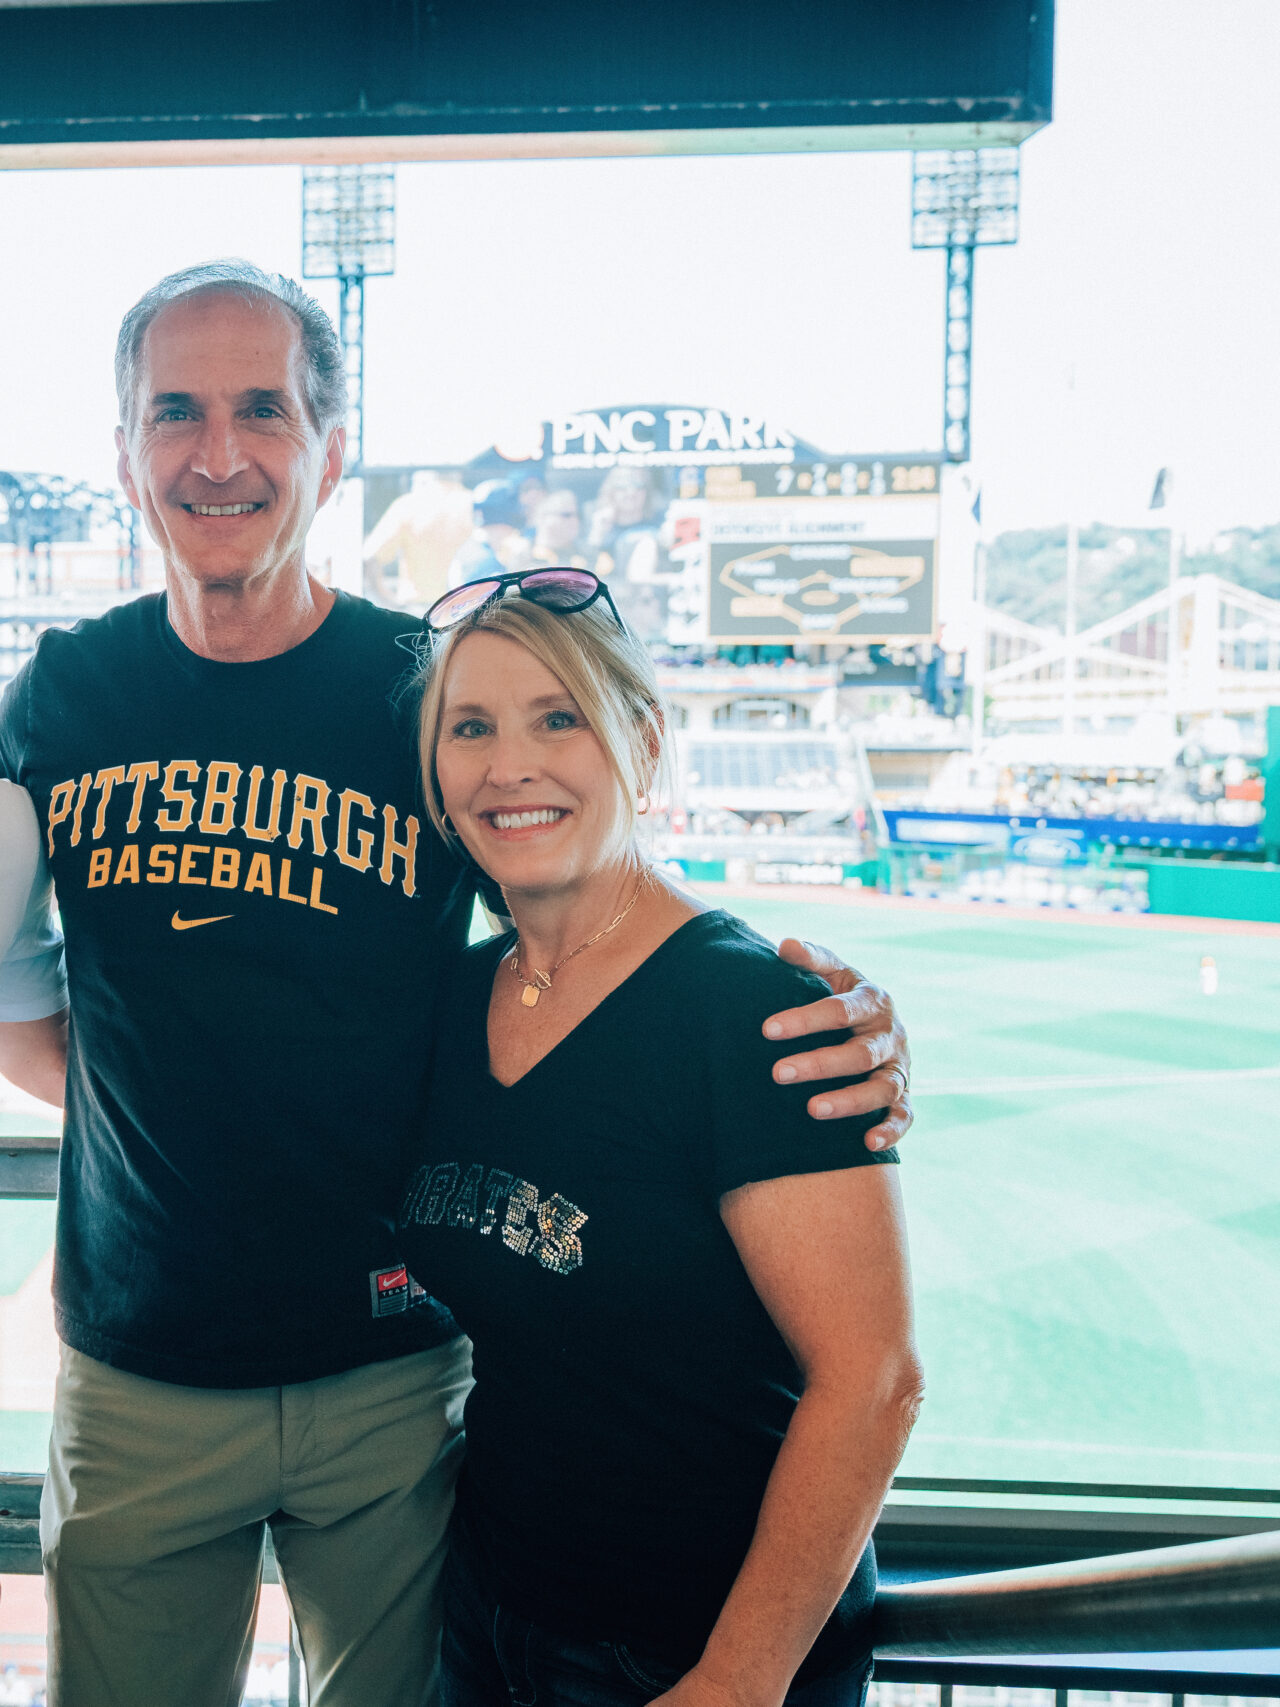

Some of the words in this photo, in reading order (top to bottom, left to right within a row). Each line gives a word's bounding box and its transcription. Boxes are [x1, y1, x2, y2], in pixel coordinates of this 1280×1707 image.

[552, 410, 656, 453] PNC
[664, 409, 796, 450] PARK
[47, 760, 420, 898] PITTSBURGH
[87, 844, 339, 915] BASEBALL
[399, 1162, 588, 1275] IRATES
